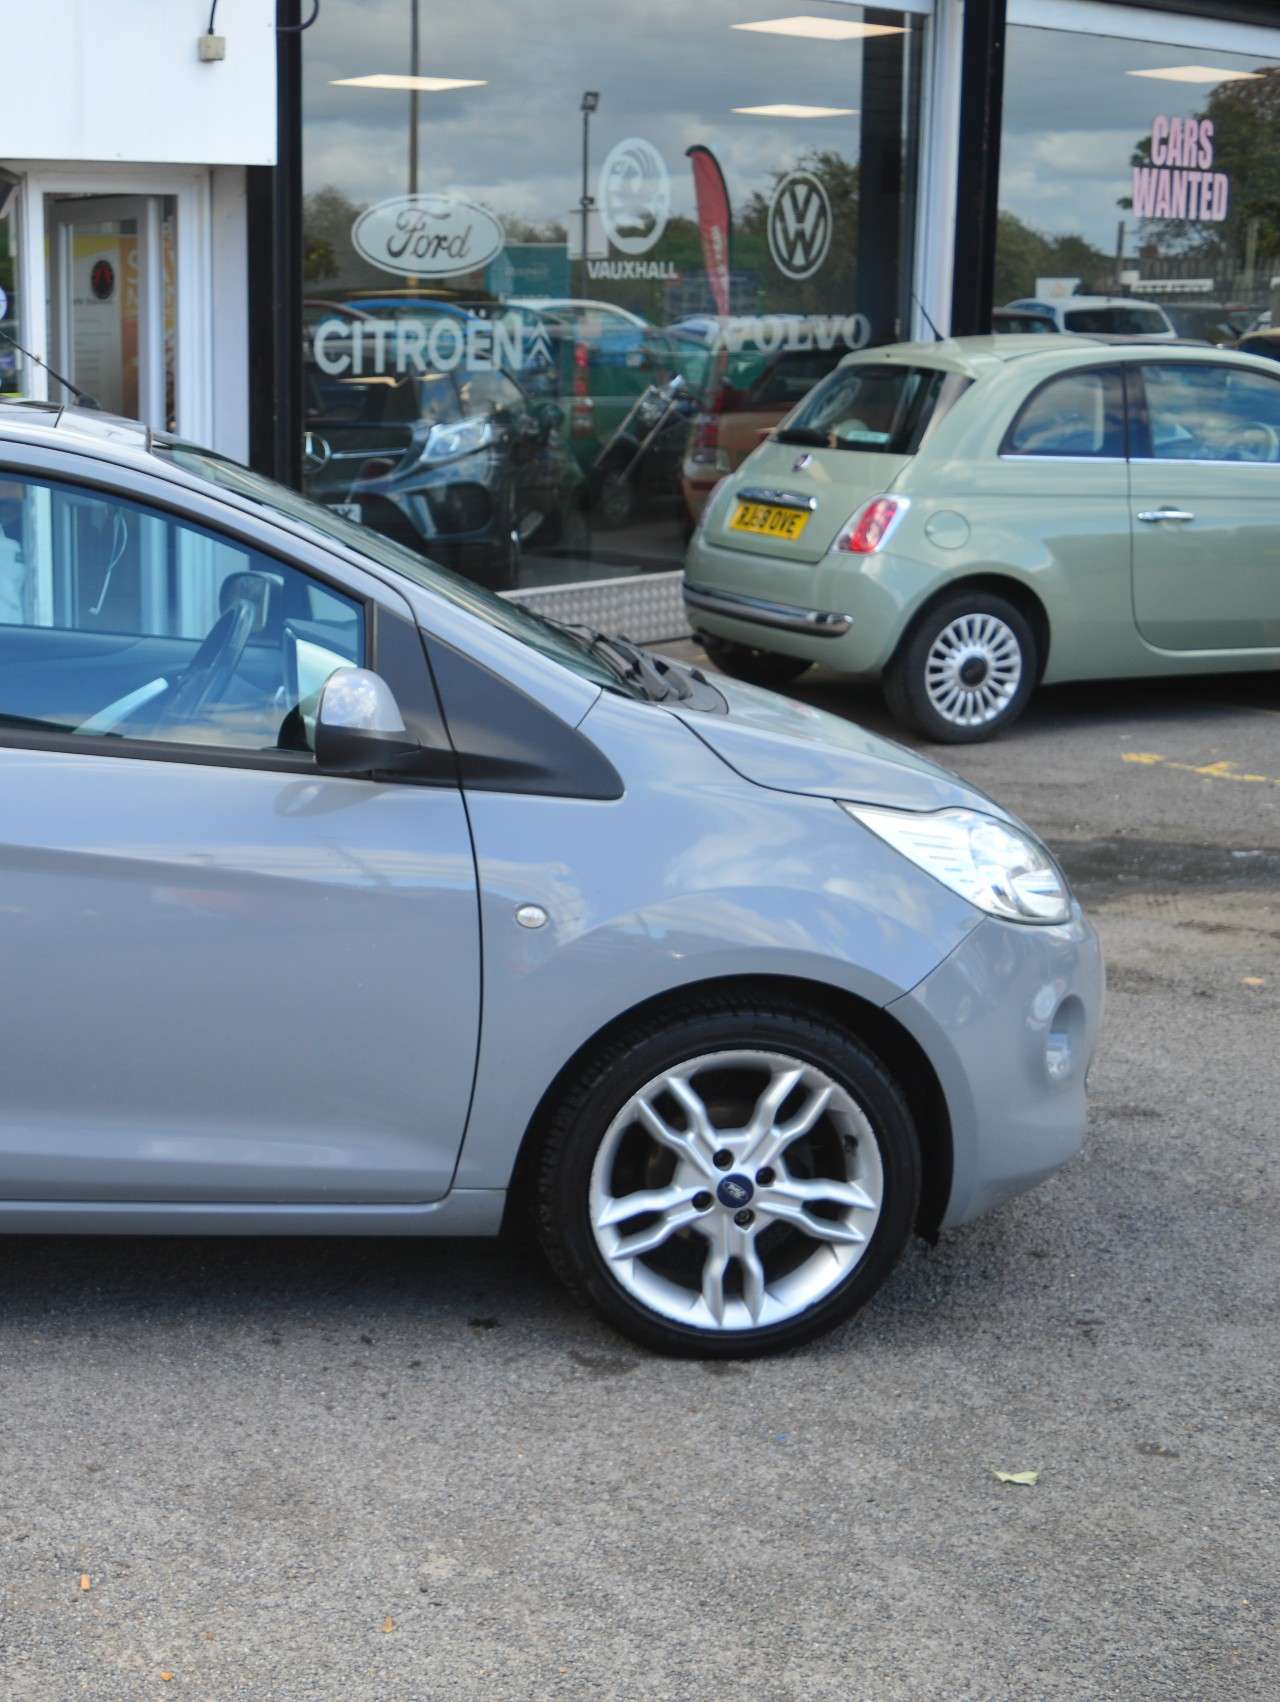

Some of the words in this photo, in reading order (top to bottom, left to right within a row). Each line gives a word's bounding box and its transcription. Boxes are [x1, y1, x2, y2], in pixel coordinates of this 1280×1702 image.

[1150, 114, 1215, 171] CARS
[1131, 166, 1229, 222] WANTED
[386, 207, 472, 259] Ford
[587, 260, 680, 280] VAUXHALL
[313, 308, 524, 376] CITROËN
[720, 313, 871, 351] VOLVO
